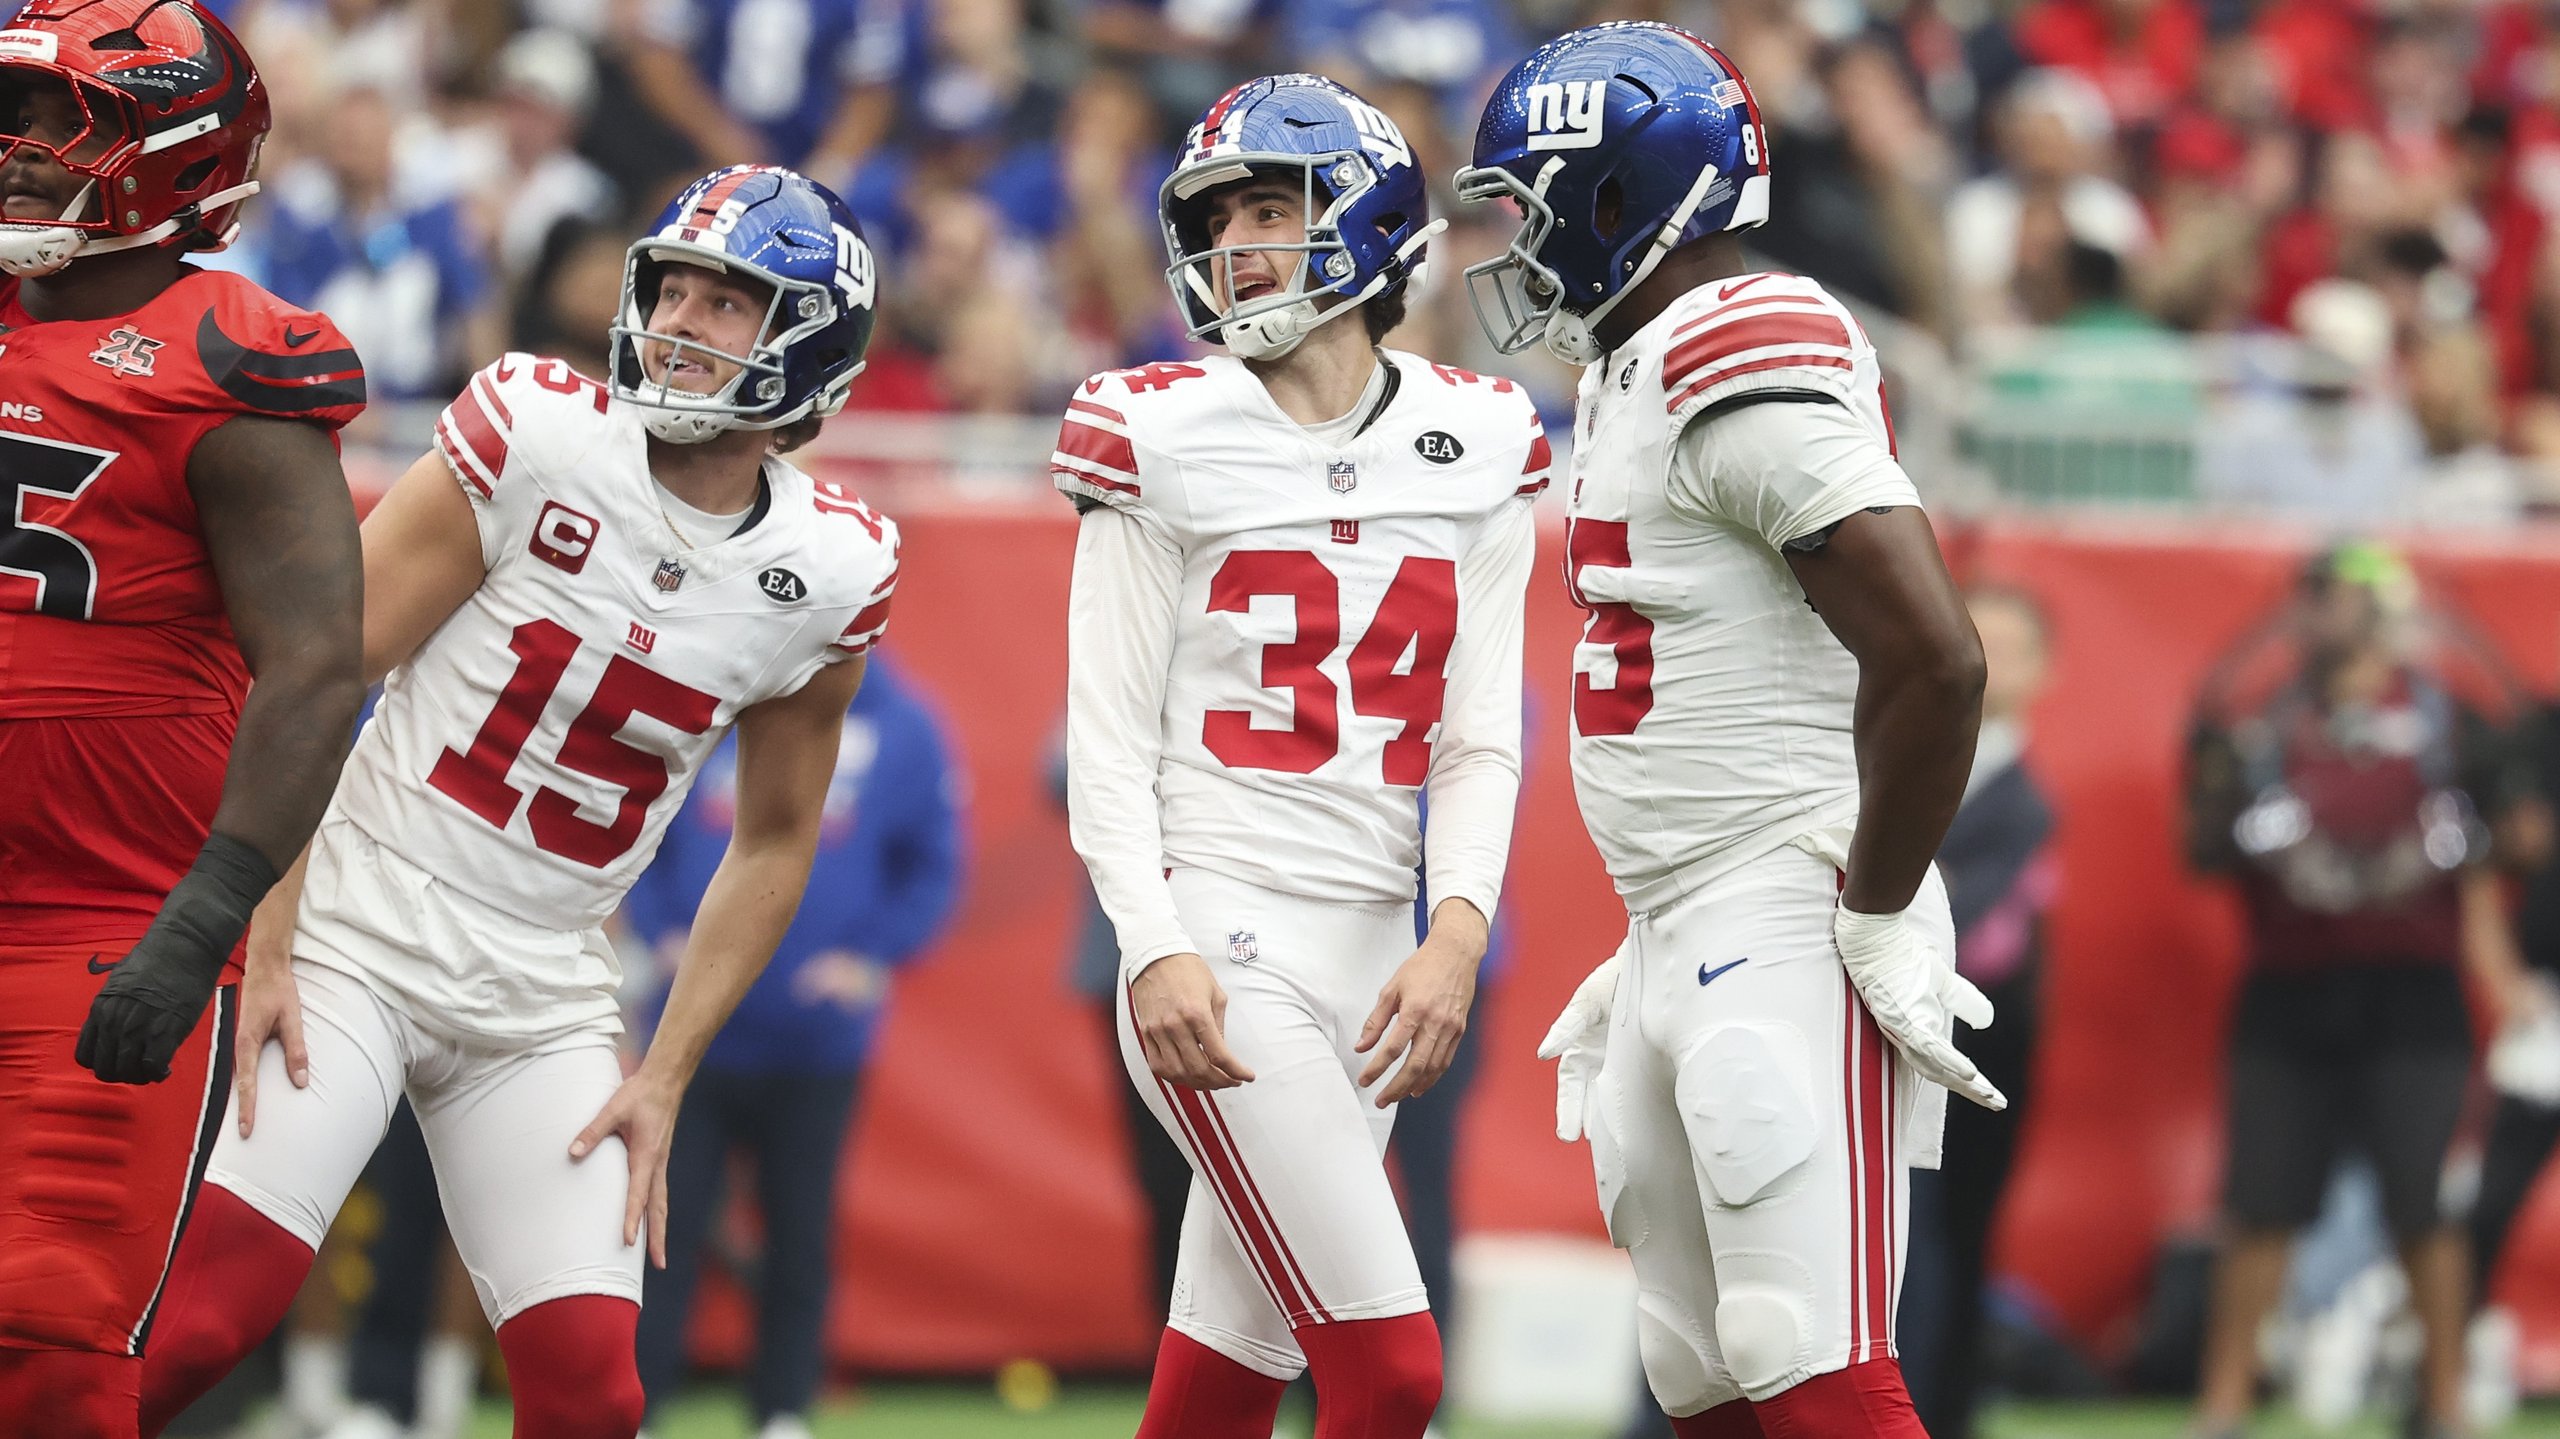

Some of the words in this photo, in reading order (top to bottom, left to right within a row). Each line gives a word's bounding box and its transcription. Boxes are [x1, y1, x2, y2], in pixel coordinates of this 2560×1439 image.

[676, 188, 748, 235] 15
[103, 329, 166, 370] 25
[1422, 436, 1458, 459] EA
[1332, 473, 1356, 489] NFL
[538, 505, 593, 557] C
[655, 569, 679, 588] NFL
[765, 569, 801, 600] EA
[1201, 551, 1458, 786] 34
[427, 618, 722, 869] 15
[1233, 942, 1258, 960] NFL
